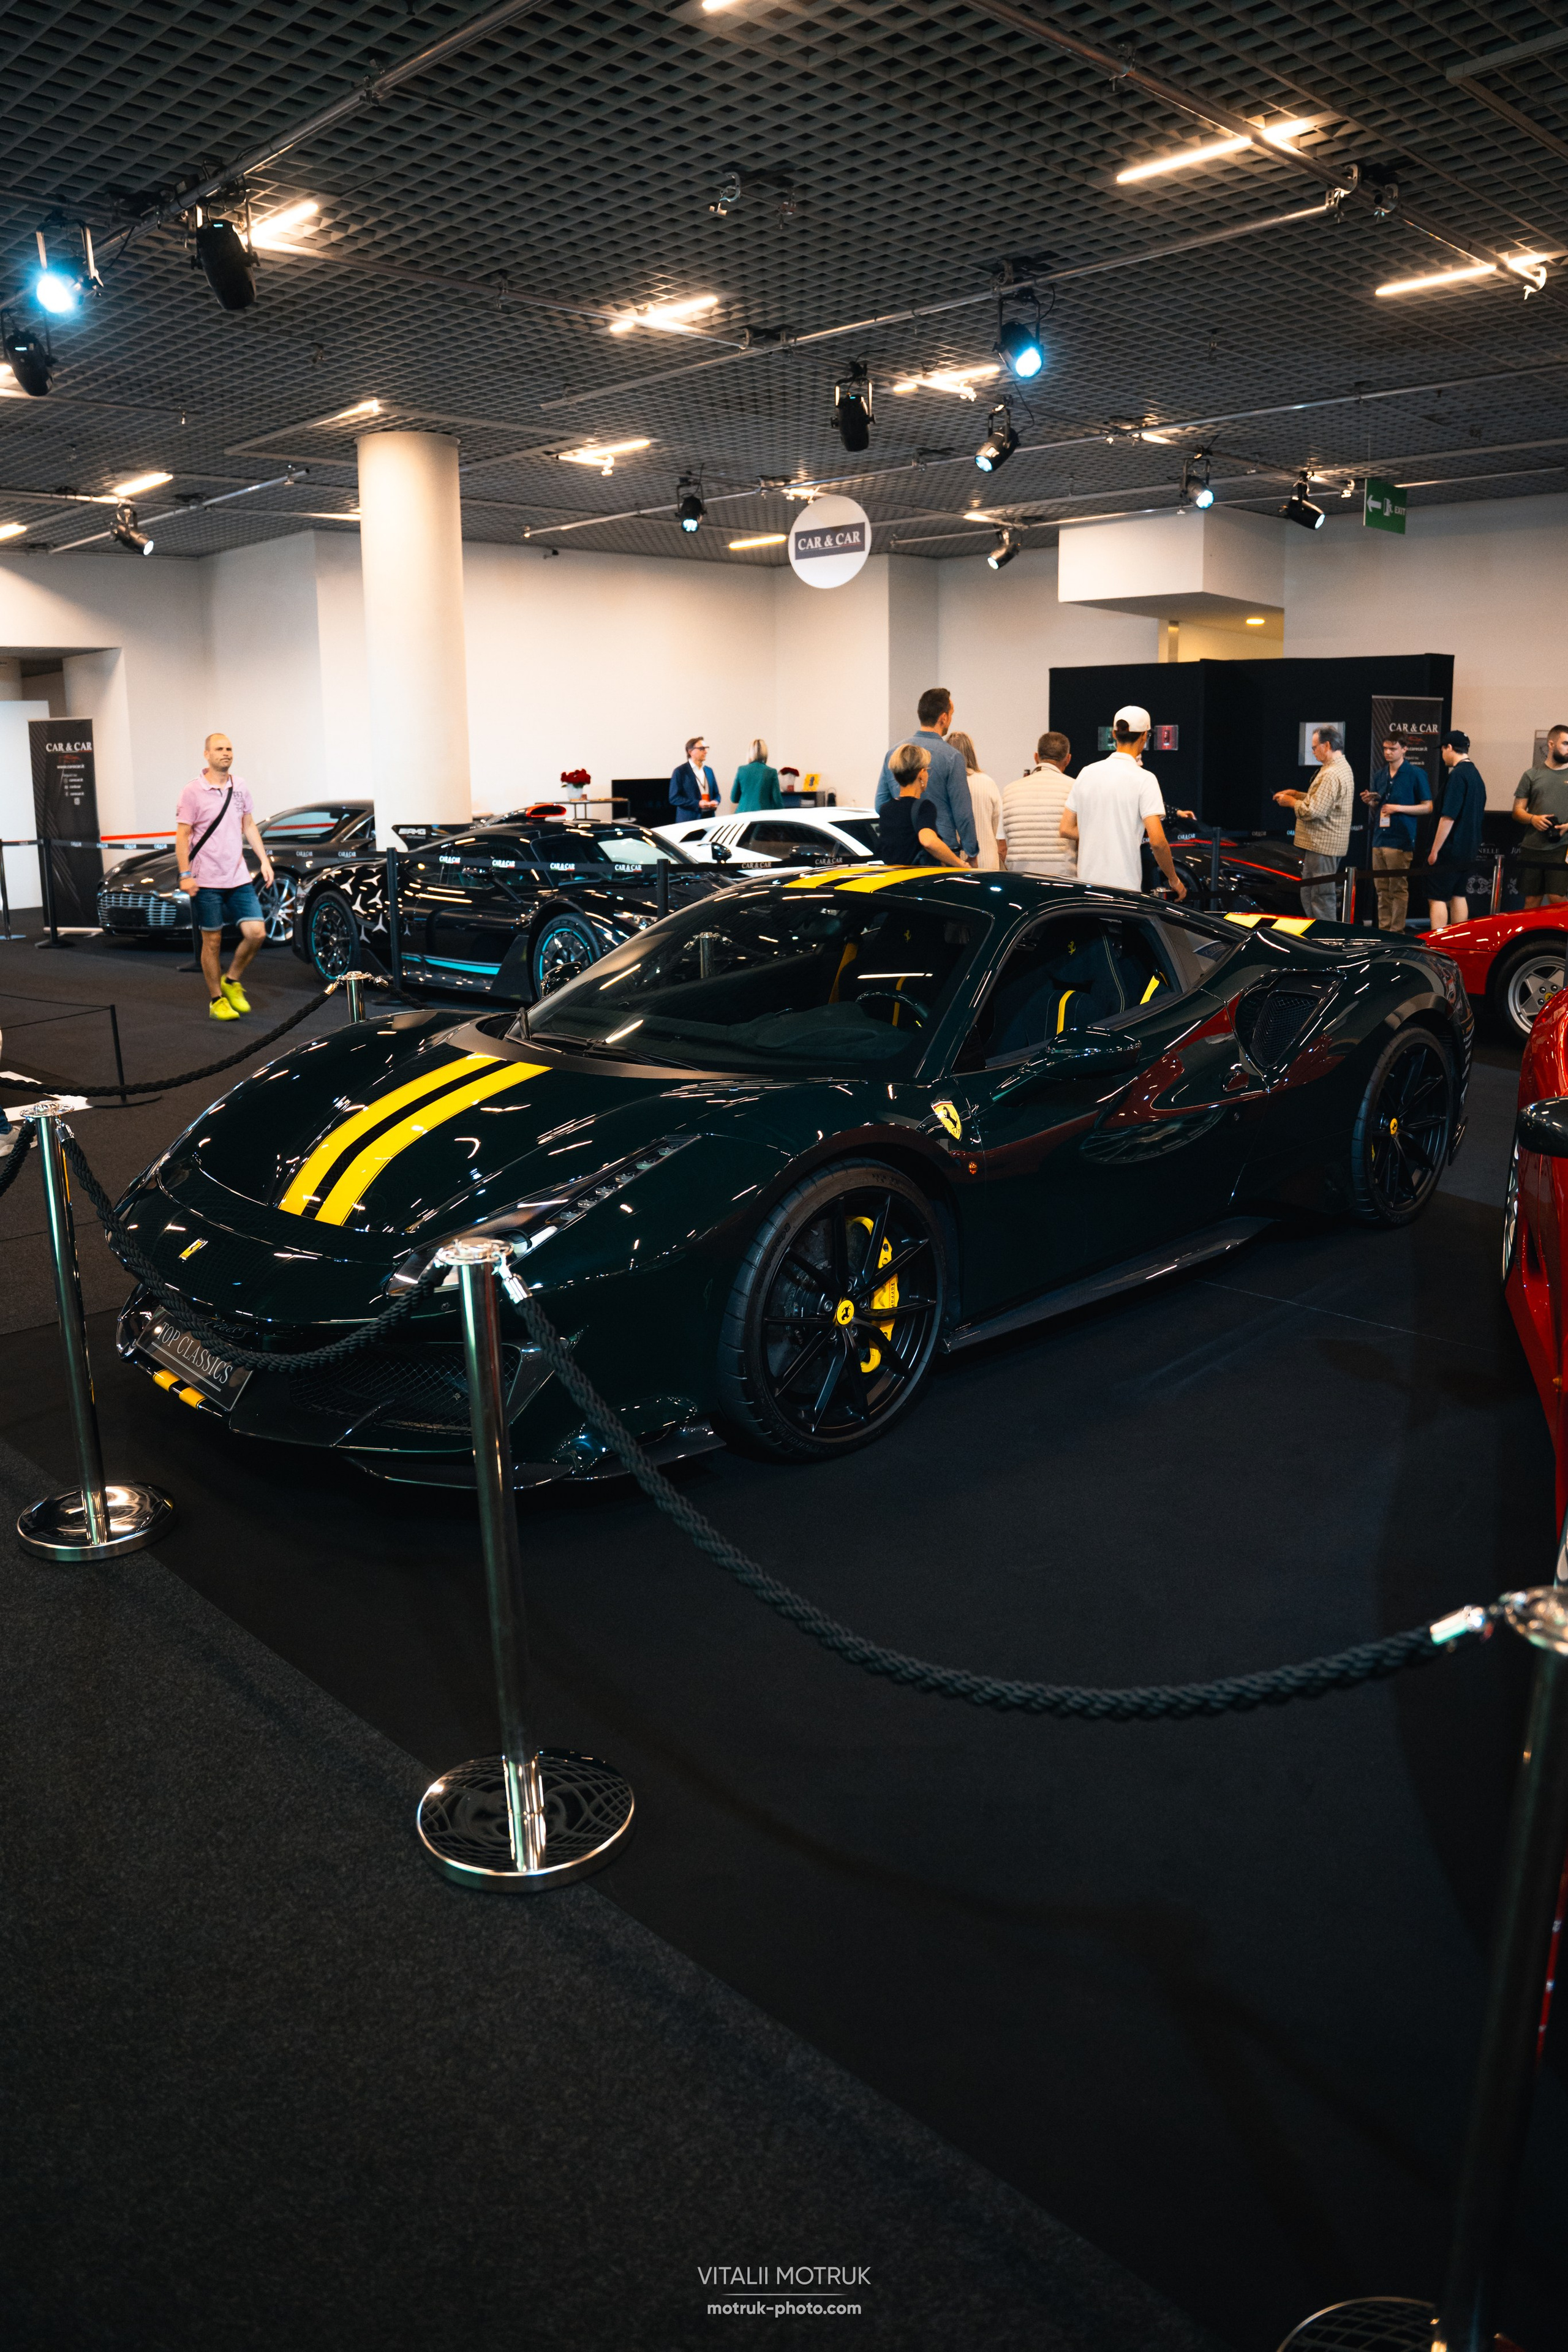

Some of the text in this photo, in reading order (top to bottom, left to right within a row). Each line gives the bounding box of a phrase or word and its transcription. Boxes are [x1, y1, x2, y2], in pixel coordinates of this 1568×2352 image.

[1394, 506, 1406, 516] EXIT
[797, 531, 861, 551] CAR & CAR
[1389, 723, 1439, 733] CAR & CAR
[46, 741, 92, 752] CAR & CAR
[157, 1321, 181, 1348] TOP
[176, 1336, 233, 1384] CLASSICS
